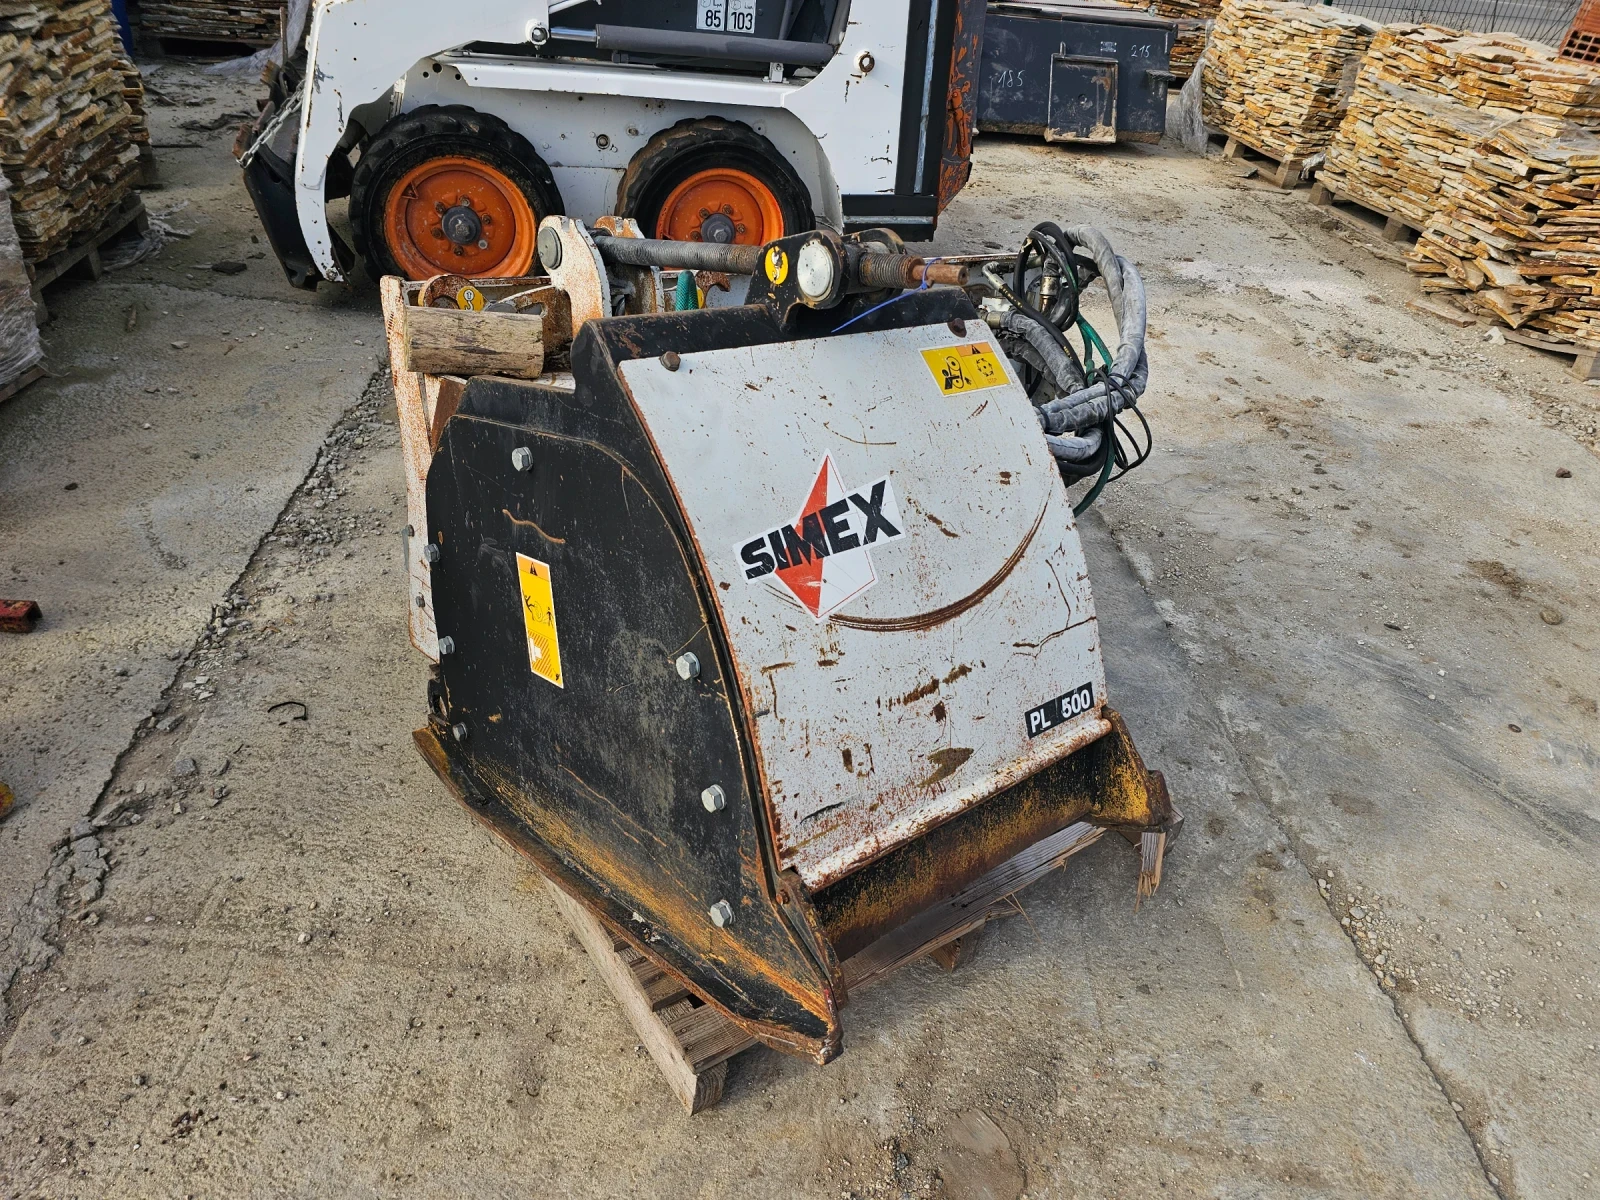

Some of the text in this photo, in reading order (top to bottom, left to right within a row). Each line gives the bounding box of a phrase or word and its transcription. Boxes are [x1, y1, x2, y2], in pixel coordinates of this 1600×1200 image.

[705, 9, 721, 28] 85
[731, 11, 753, 30] 103
[1130, 44, 1152, 58] 215
[998, 69, 1025, 88] 185
[740, 479, 902, 580] SIMEX
[1029, 689, 1091, 733] PL 500
